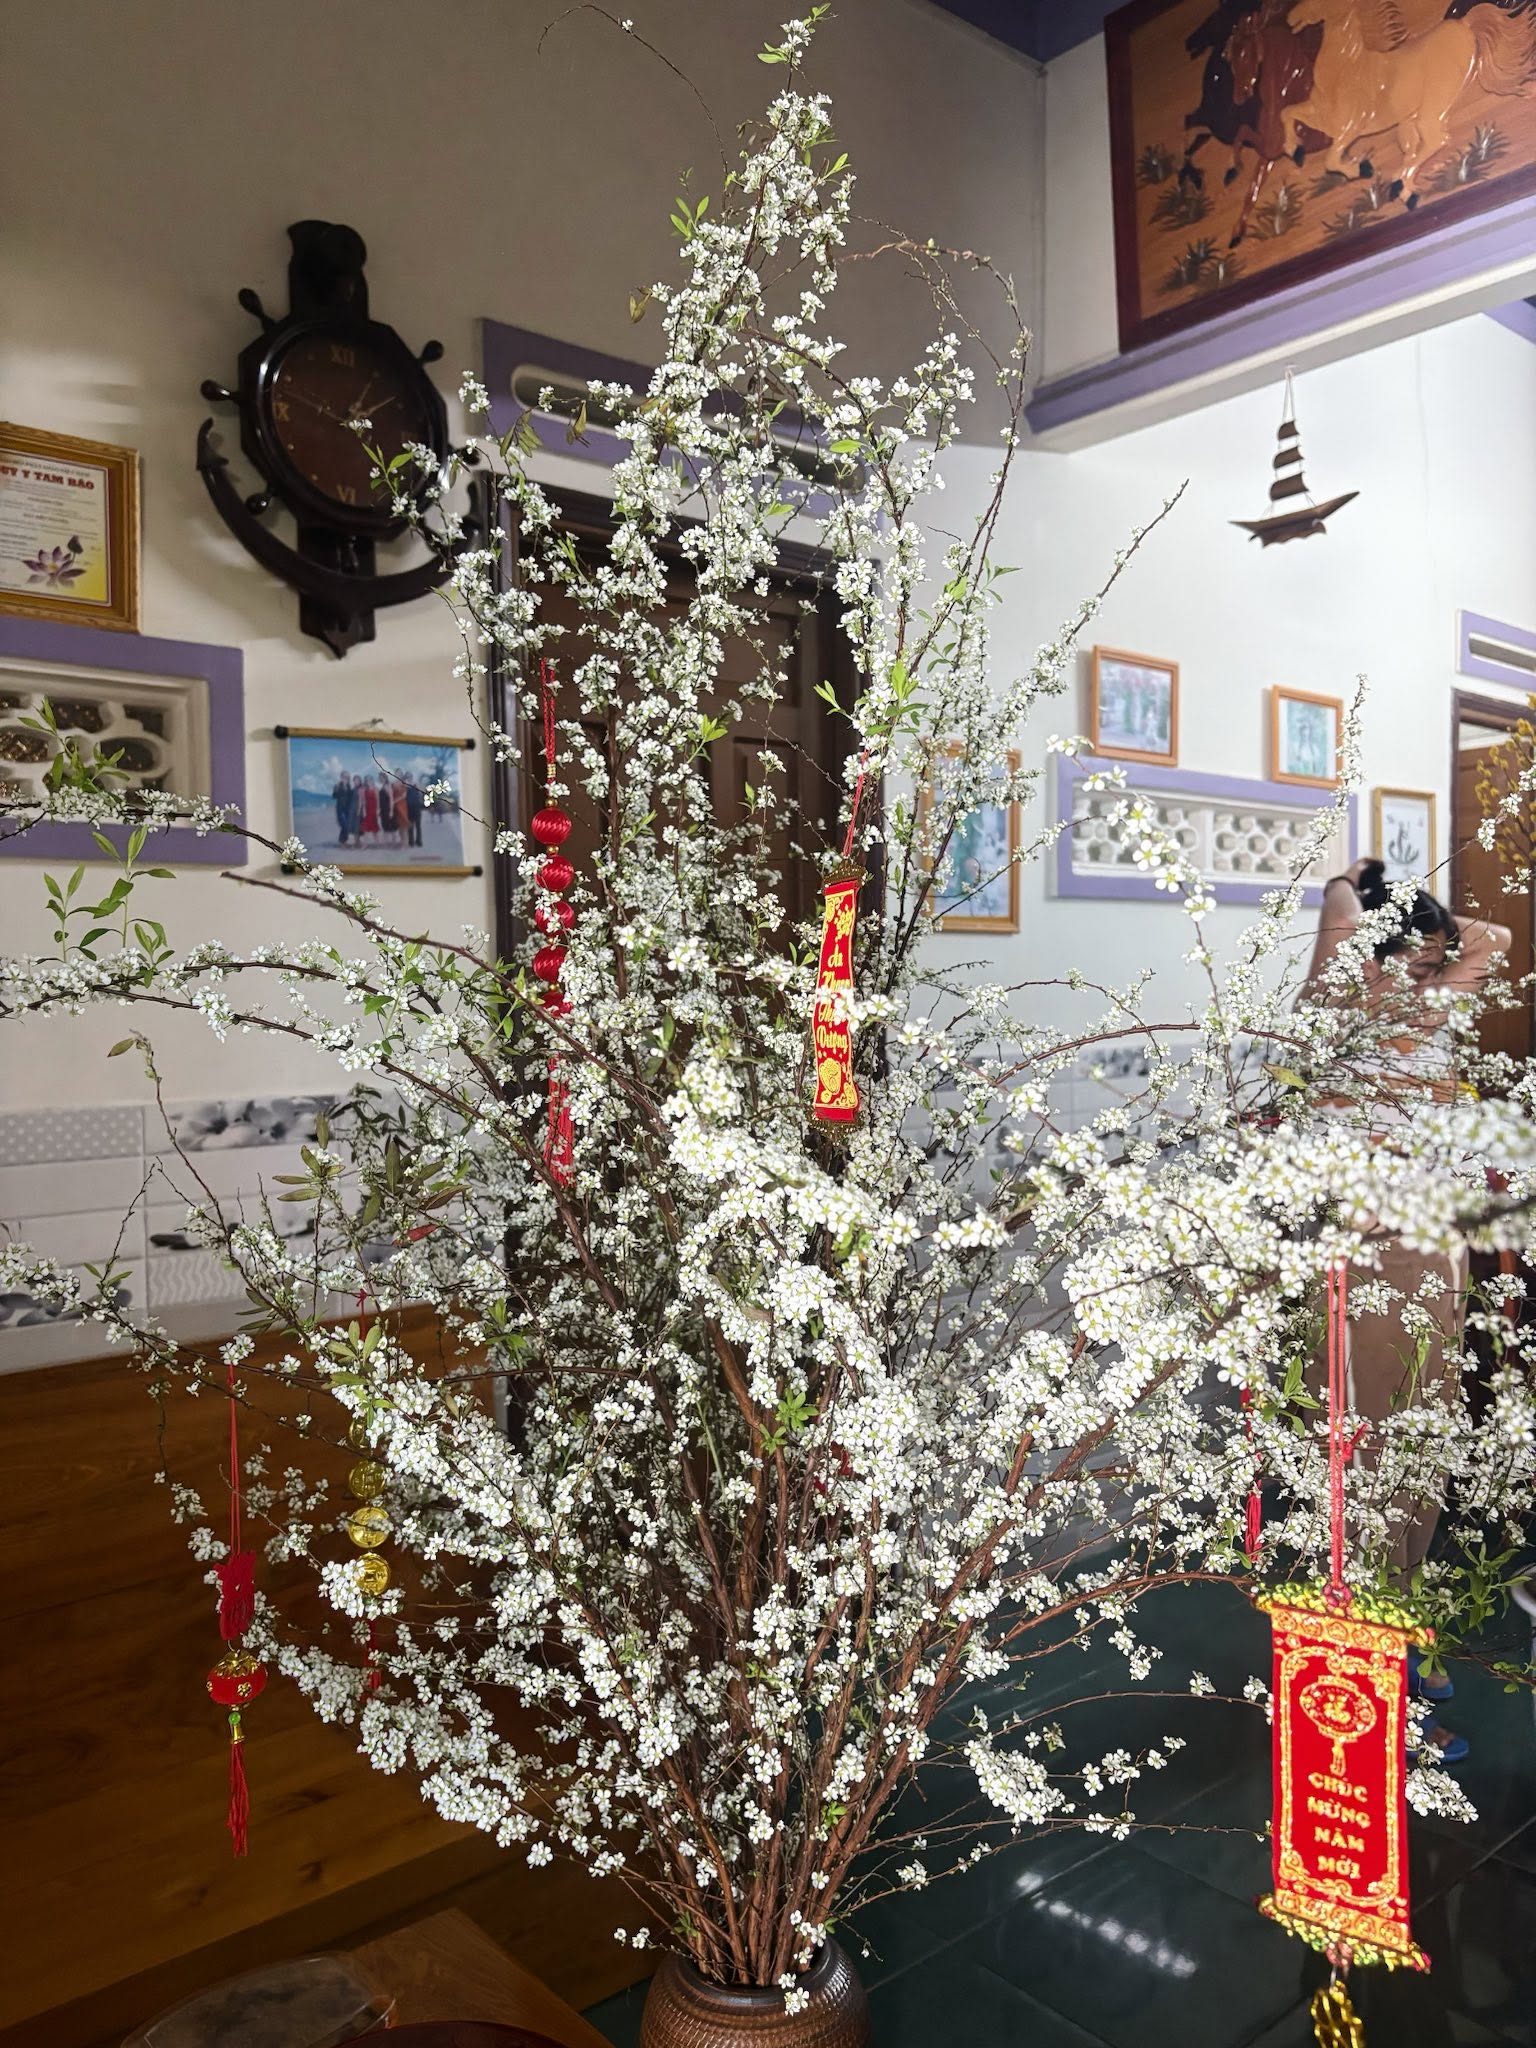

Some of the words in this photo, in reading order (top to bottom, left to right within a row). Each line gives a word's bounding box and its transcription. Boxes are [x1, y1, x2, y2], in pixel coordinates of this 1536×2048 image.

[0, 465, 18, 477] UY
[34, 471, 64, 485] TAM
[1308, 1771, 1368, 1803] CHÚC
[1307, 1796, 1371, 1829] MỪNG
[1314, 1825, 1365, 1853] NĂM
[1317, 1854, 1361, 1879] MỚI
